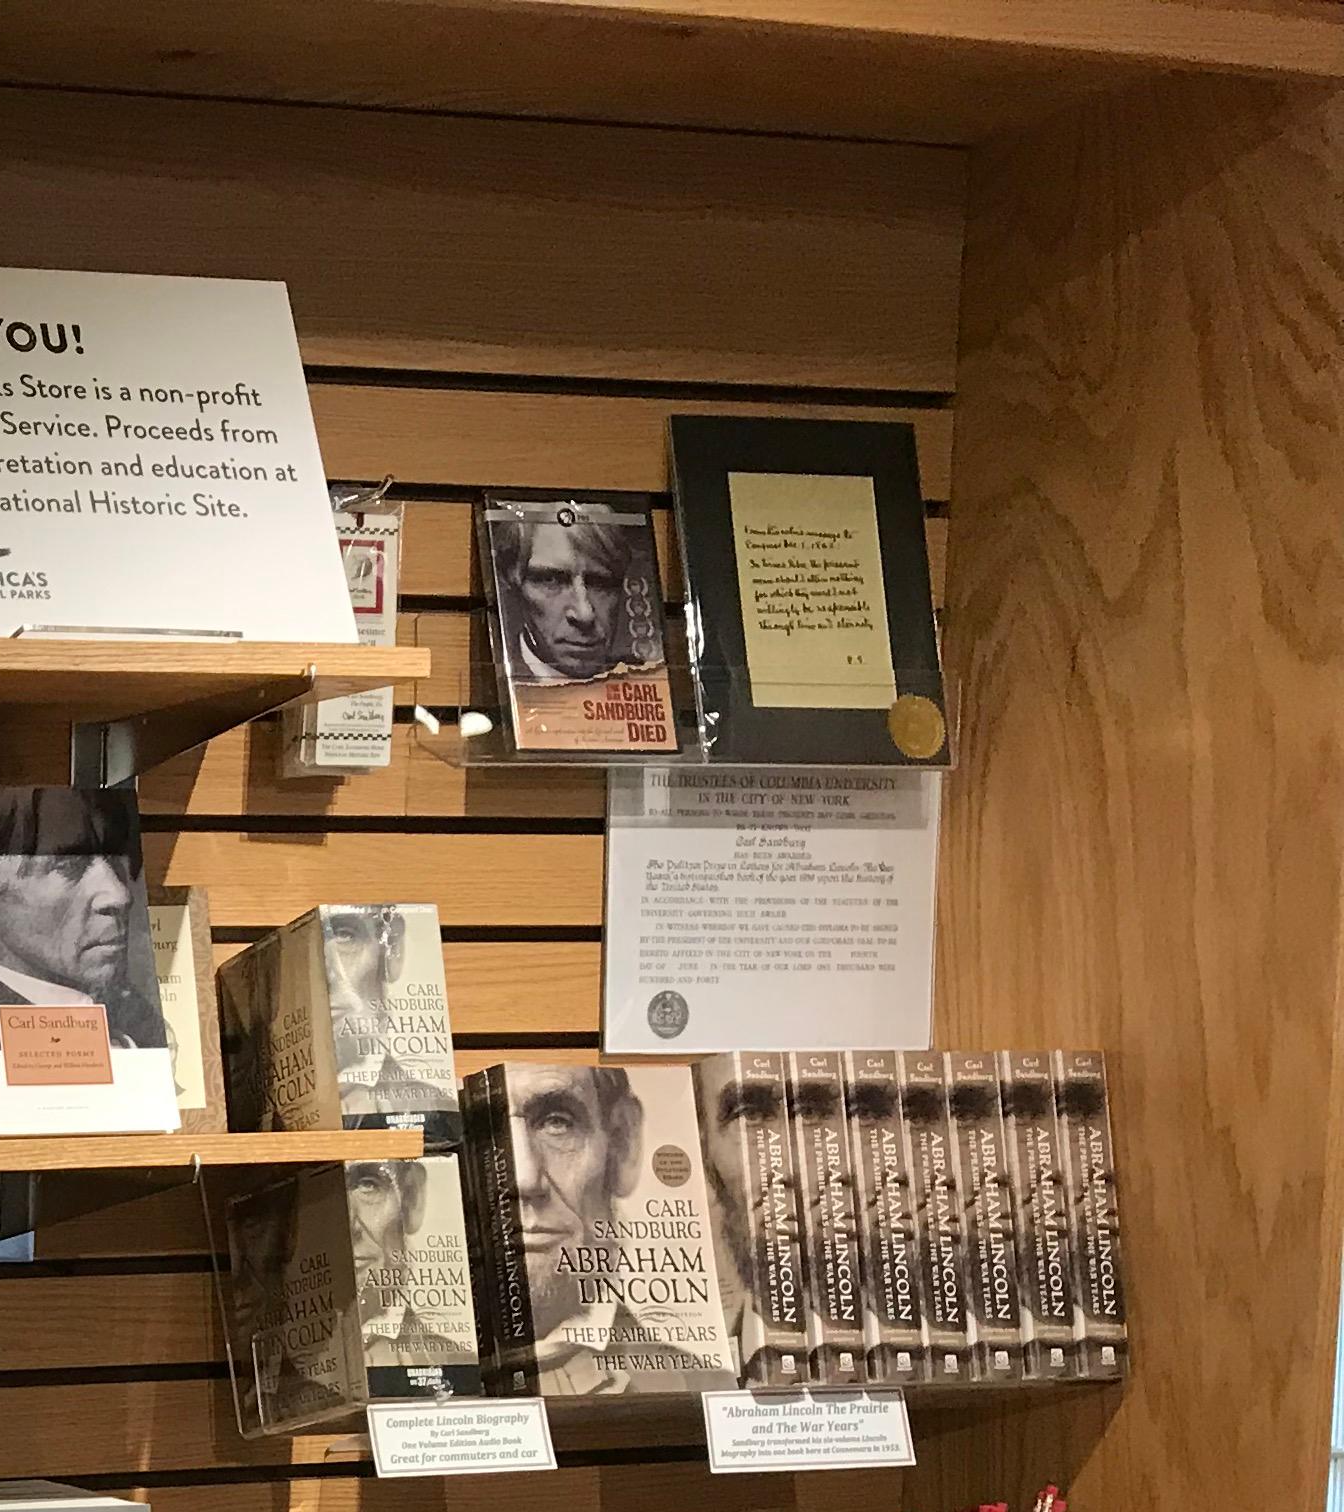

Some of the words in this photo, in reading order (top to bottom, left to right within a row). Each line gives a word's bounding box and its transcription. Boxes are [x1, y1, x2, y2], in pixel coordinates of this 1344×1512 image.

[20, 374, 86, 401] Store
[94, 378, 111, 401] is
[120, 387, 131, 402] a
[139, 381, 261, 409] non-profit
[1, 413, 98, 439] Service.
[105, 416, 213, 442] Proceeds
[220, 419, 278, 444] from
[101, 454, 142, 478] and
[151, 456, 267, 482] education
[274, 462, 298, 482] at
[90, 490, 187, 516] Historic
[194, 494, 249, 519] Site.
[10, 589, 51, 599] PARKS
[622, 682, 663, 704] CARL
[584, 700, 665, 722] SANDBURG
[628, 722, 667, 744] DIED
[8, 1015, 37, 1031] Carl
[39, 1015, 98, 1033] Sandburg
[646, 1198, 700, 1219] CARL
[593, 1218, 702, 1241] SANDBURG
[558, 1246, 705, 1275] ABRAHAM
[580, 1277, 710, 1306] LINCOLN
